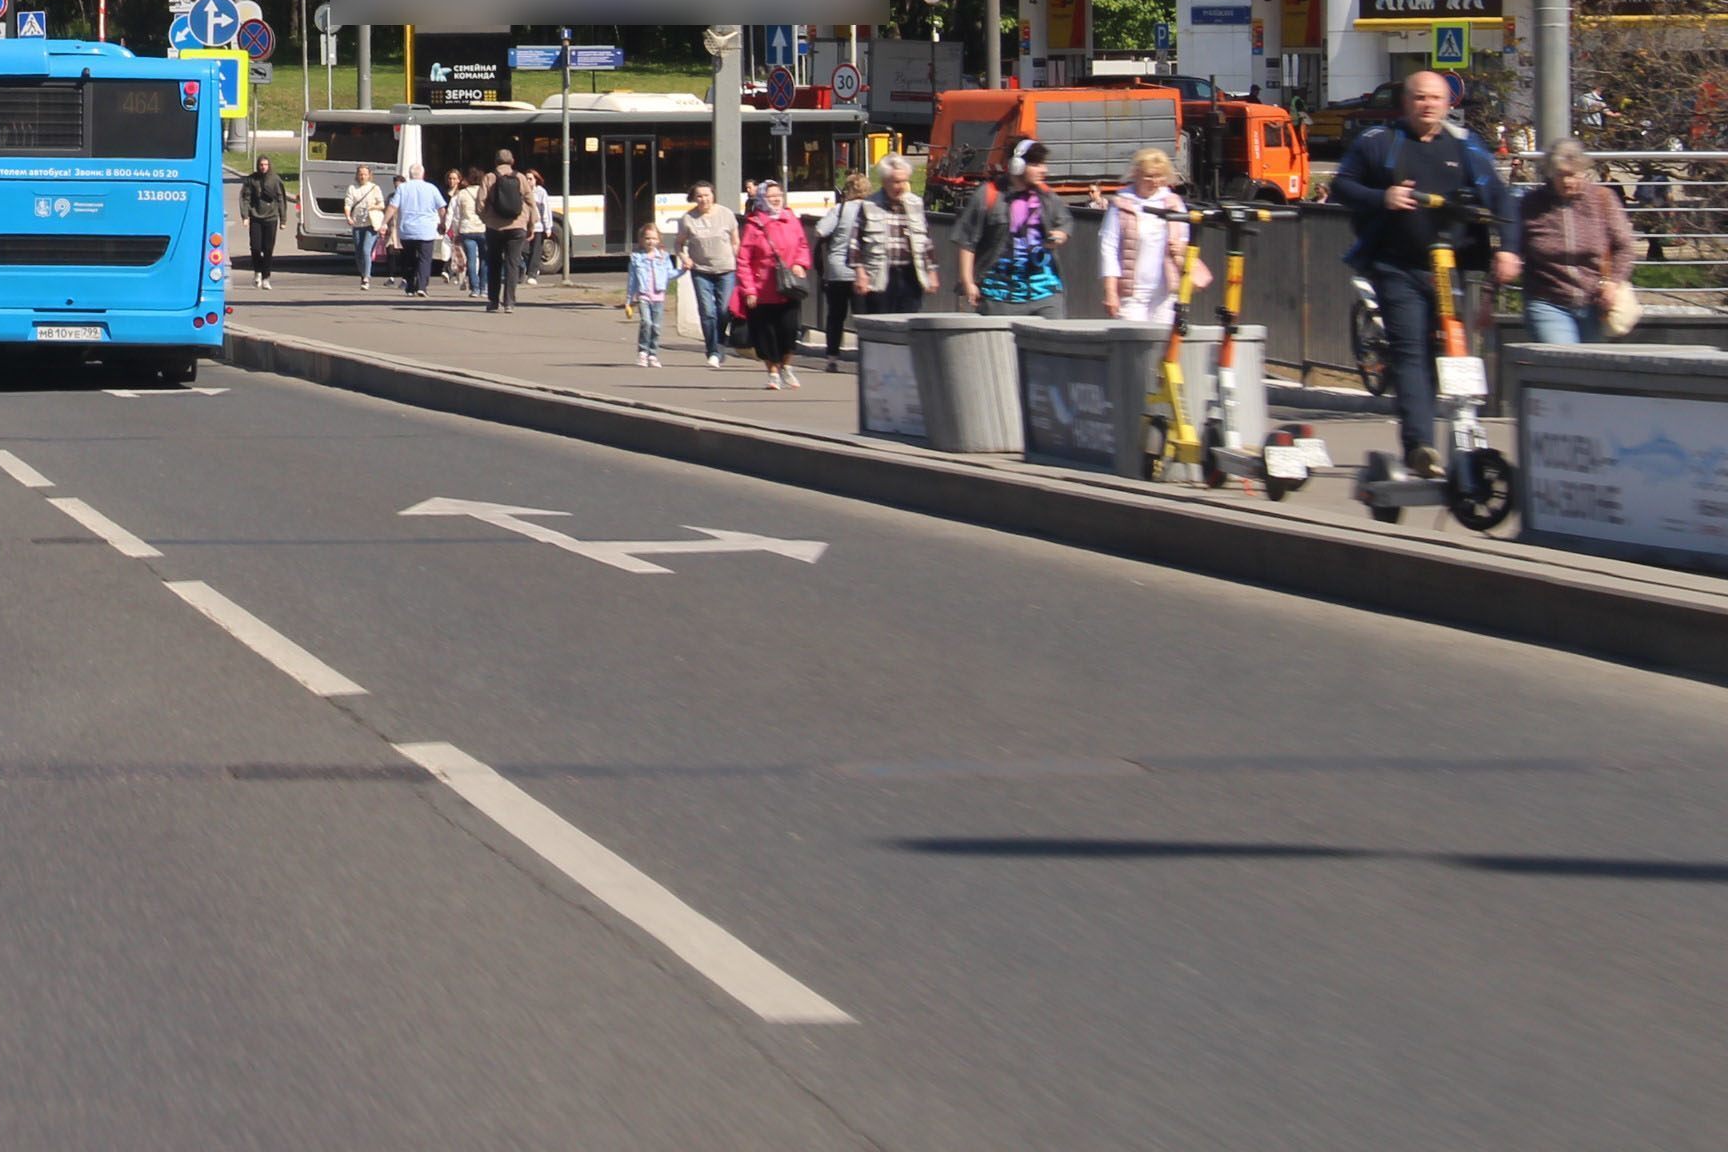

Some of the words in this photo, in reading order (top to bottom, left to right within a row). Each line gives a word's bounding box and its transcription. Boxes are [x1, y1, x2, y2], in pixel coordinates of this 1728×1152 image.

[453, 63, 497, 72] СЕМЕЙНАЯ
[453, 72, 495, 80] КОМАНДА
[837, 75, 854, 90] 30
[445, 89, 482, 100] ЗЕРНО
[28, 167, 71, 177] автобуса!
[74, 168, 104, 177] Звони:
[105, 169, 112, 177] 8
[113, 169, 132, 177] 800
[133, 169, 151, 177] 444
[152, 169, 164, 178] 05
[166, 169, 179, 178] 20
[137, 190, 187, 201] 1318003
